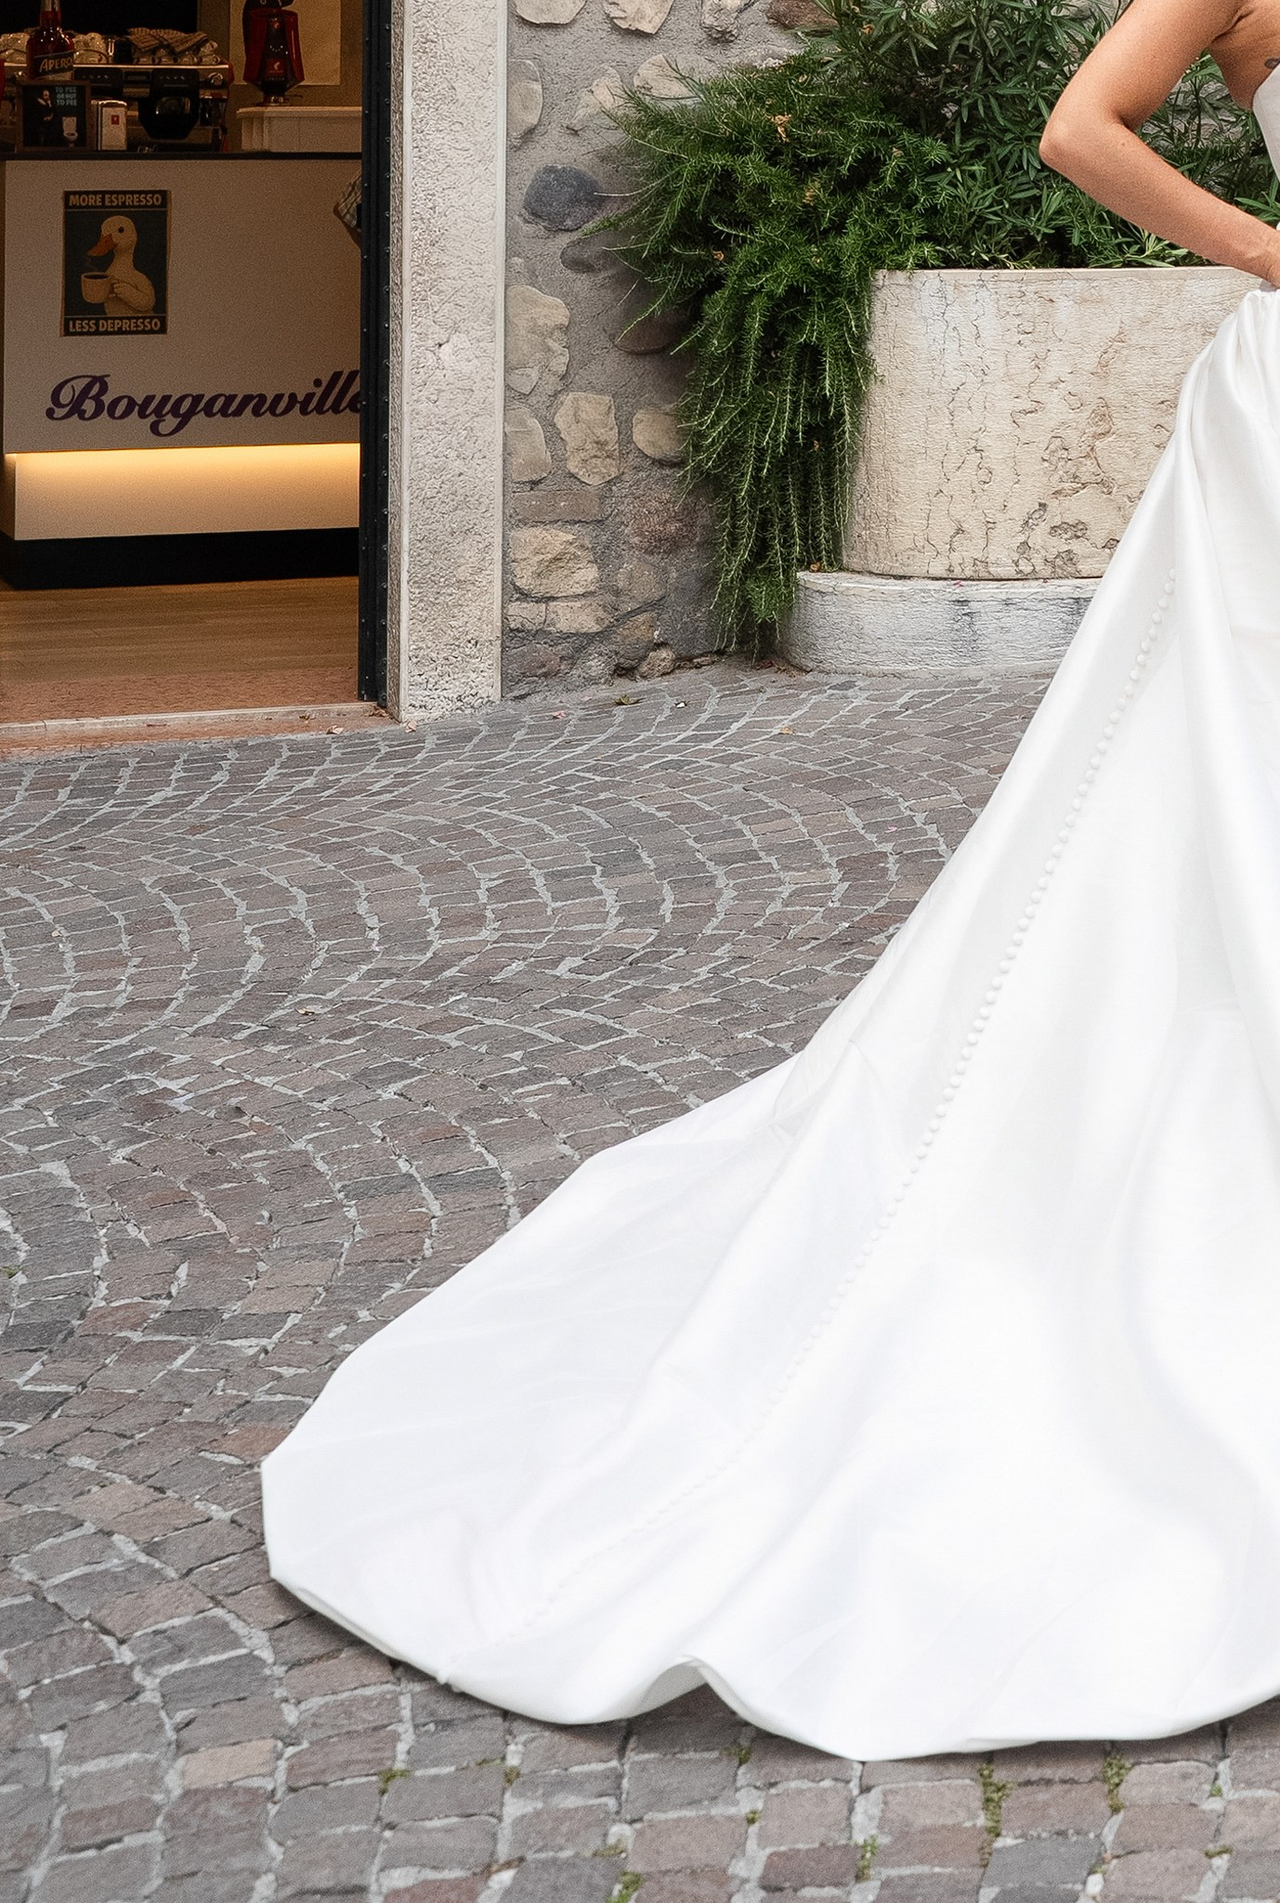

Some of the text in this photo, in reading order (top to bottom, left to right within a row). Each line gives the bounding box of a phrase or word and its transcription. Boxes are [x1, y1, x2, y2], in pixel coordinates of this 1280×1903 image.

[39, 56, 73, 73] APERO
[68, 192, 162, 207] MORE ESPRESSO
[69, 317, 161, 333] LESS DEPRESSO
